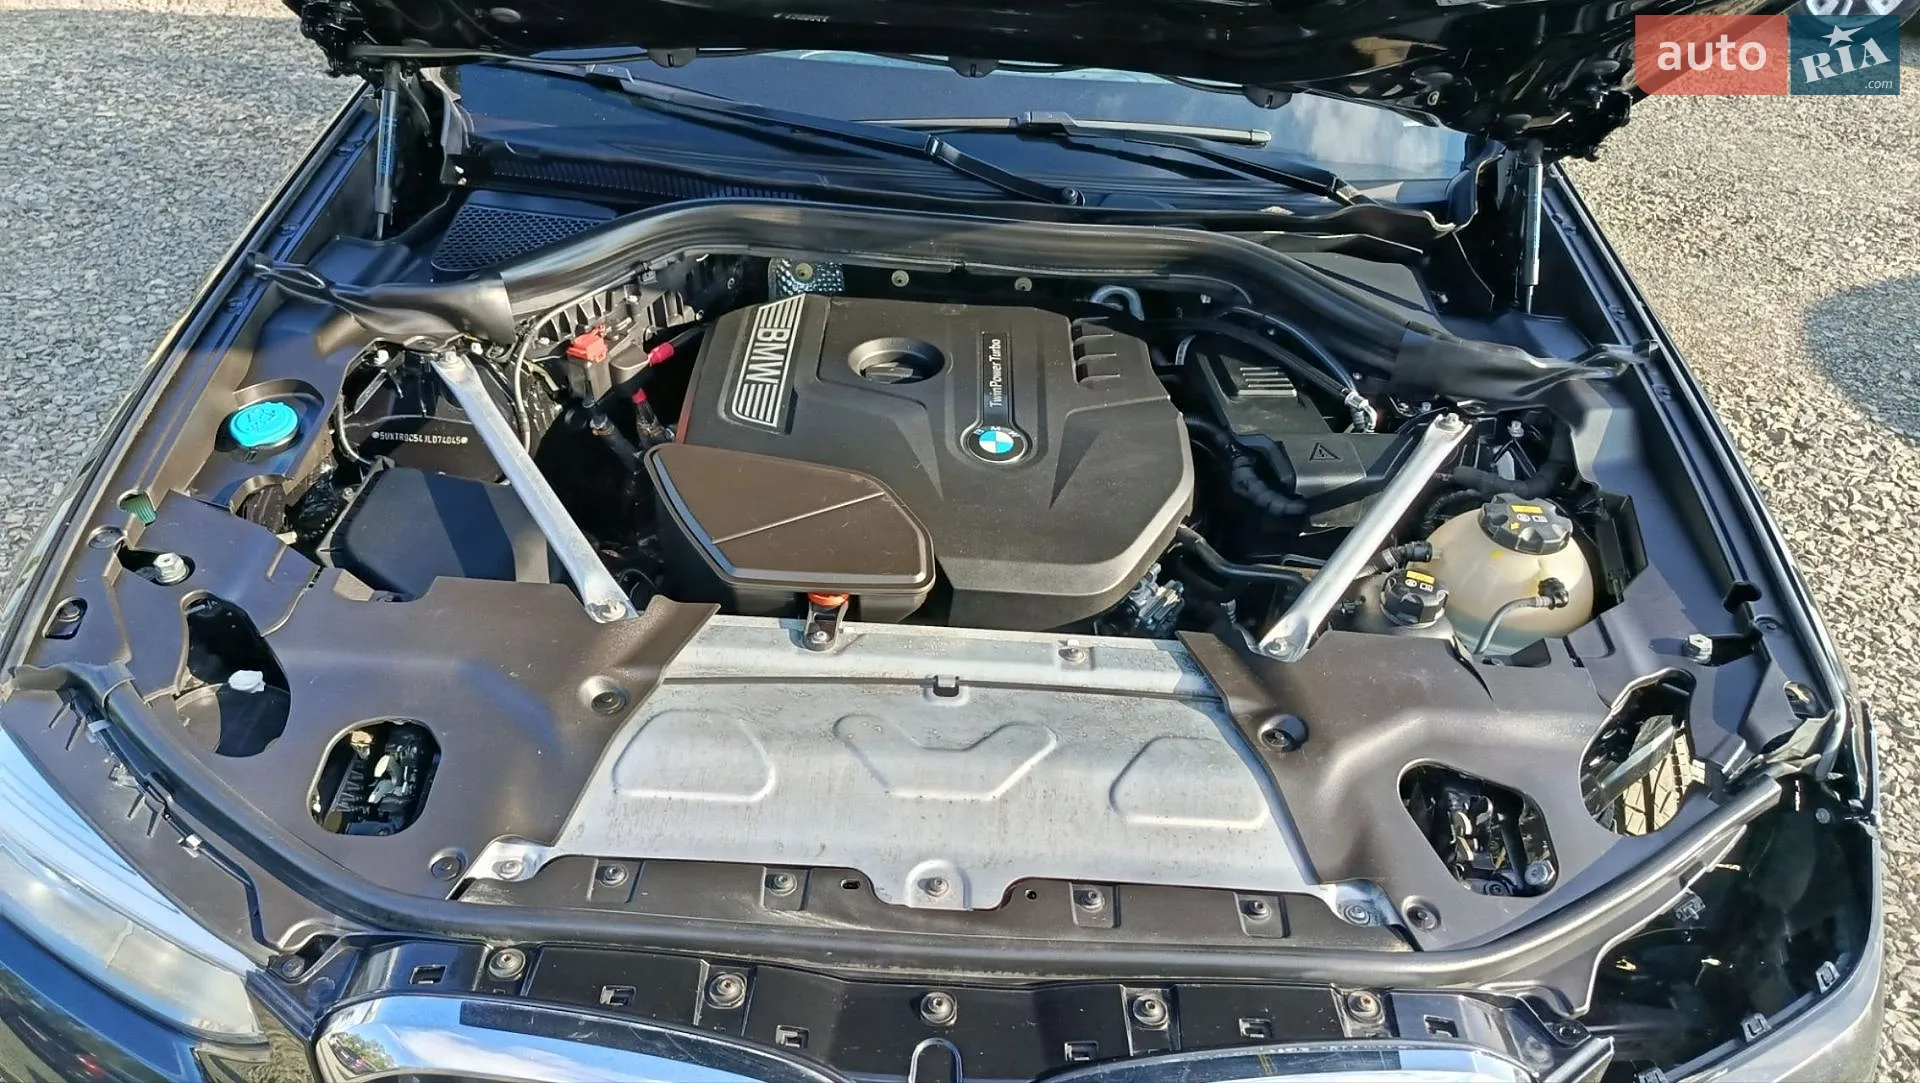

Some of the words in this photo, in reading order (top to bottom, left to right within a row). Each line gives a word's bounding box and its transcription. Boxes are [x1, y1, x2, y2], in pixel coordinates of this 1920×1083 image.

[745, 328, 791, 384] BMW
[988, 339, 1002, 362] Turbo
[989, 362, 1002, 407] TwinPower
